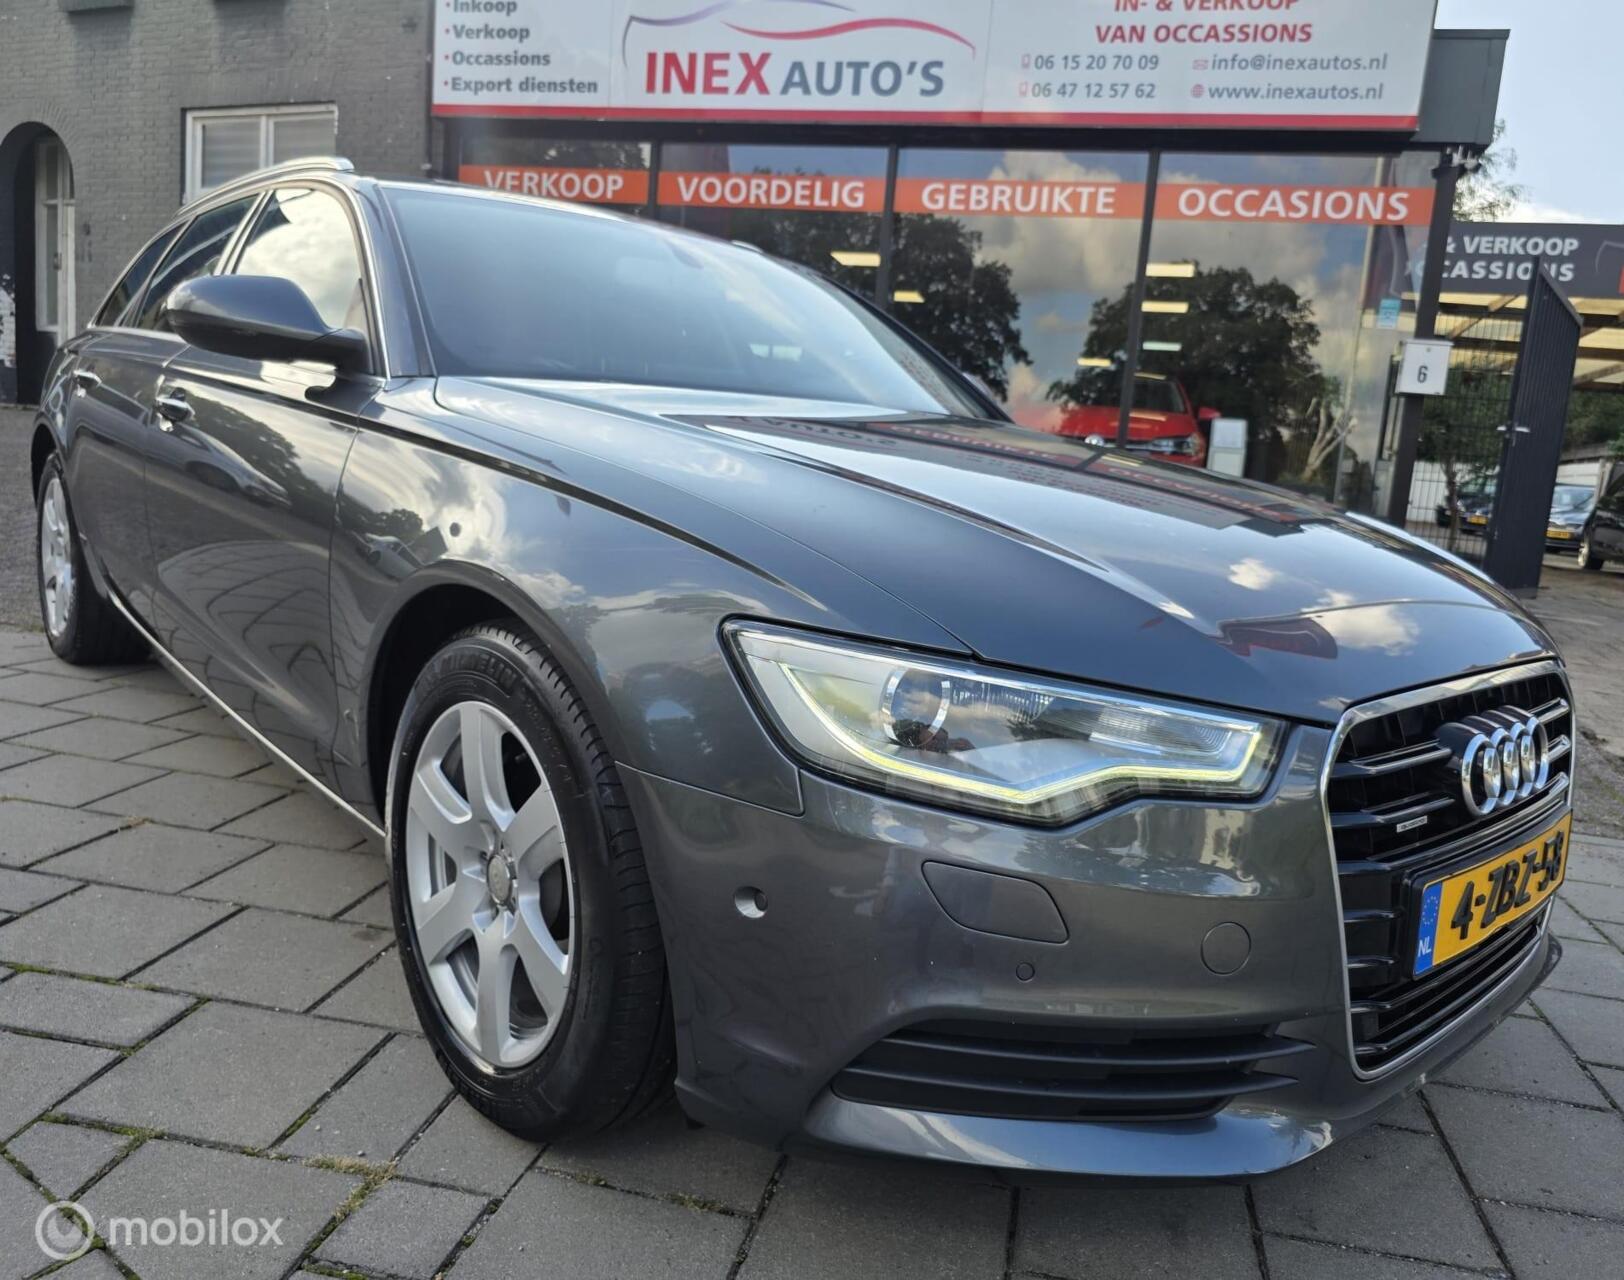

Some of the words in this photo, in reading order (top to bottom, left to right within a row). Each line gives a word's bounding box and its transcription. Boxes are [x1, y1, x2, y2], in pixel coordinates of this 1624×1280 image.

[453, 0, 517, 16] Inkoop
[1184, 0, 1299, 11] VERKOOP
[452, 23, 531, 43] Verkoop
[1095, 24, 1145, 43] VAN
[1153, 23, 1313, 43] OCCASSIONS
[451, 50, 551, 66] Occassions
[1034, 54, 1055, 71] 06
[1061, 54, 1081, 71] 15
[1085, 54, 1107, 71] 20
[1112, 54, 1133, 71] 70
[1137, 54, 1160, 71] 09
[1211, 53, 1389, 71] info@inexautos.nl
[645, 51, 771, 96] INEX
[779, 60, 944, 97] AUTO'S
[451, 77, 513, 95] Export
[518, 76, 599, 94] diensten
[1031, 82, 1053, 98] 06
[1056, 82, 1078, 98] 47
[1084, 82, 1104, 98] 12
[1108, 82, 1130, 99] 57
[1134, 82, 1157, 99] 62
[1208, 82, 1385, 100] www.inexautos.nl
[483, 169, 624, 200] VERKOOP
[677, 175, 866, 208] VOORDELIG
[920, 182, 1116, 215] GEBRUIKTE
[1177, 187, 1410, 221] OCCASIONS
[1463, 235, 1580, 256] VERKOOP
[1417, 365, 1429, 384] 6
[1417, 936, 1432, 958] NL
